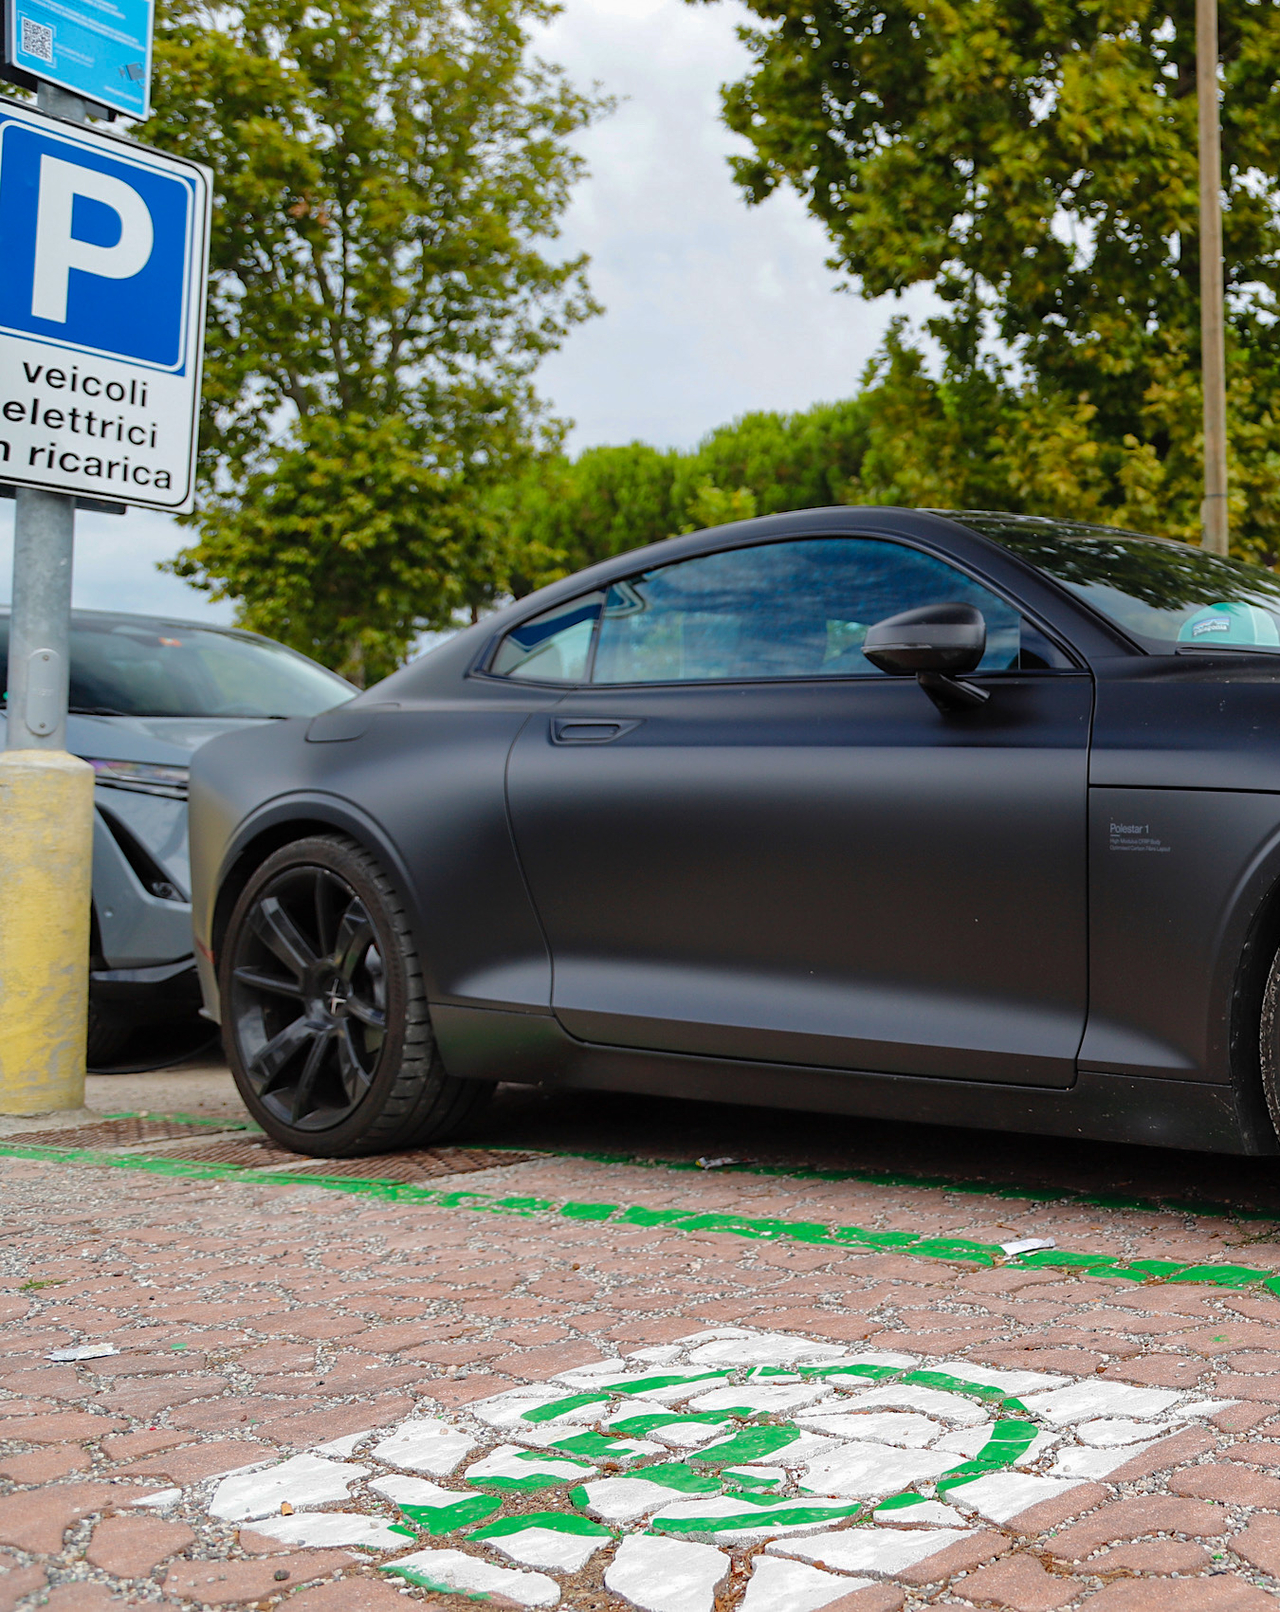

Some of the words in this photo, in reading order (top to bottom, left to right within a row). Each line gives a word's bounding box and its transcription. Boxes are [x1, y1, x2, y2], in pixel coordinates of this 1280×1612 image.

[31, 153, 154, 324] P
[22, 361, 149, 407] veicoli
[2, 398, 157, 448] elettrici
[28, 442, 172, 490] ricarica
[1110, 823, 1143, 834] Polestar
[1144, 824, 1149, 834] 1
